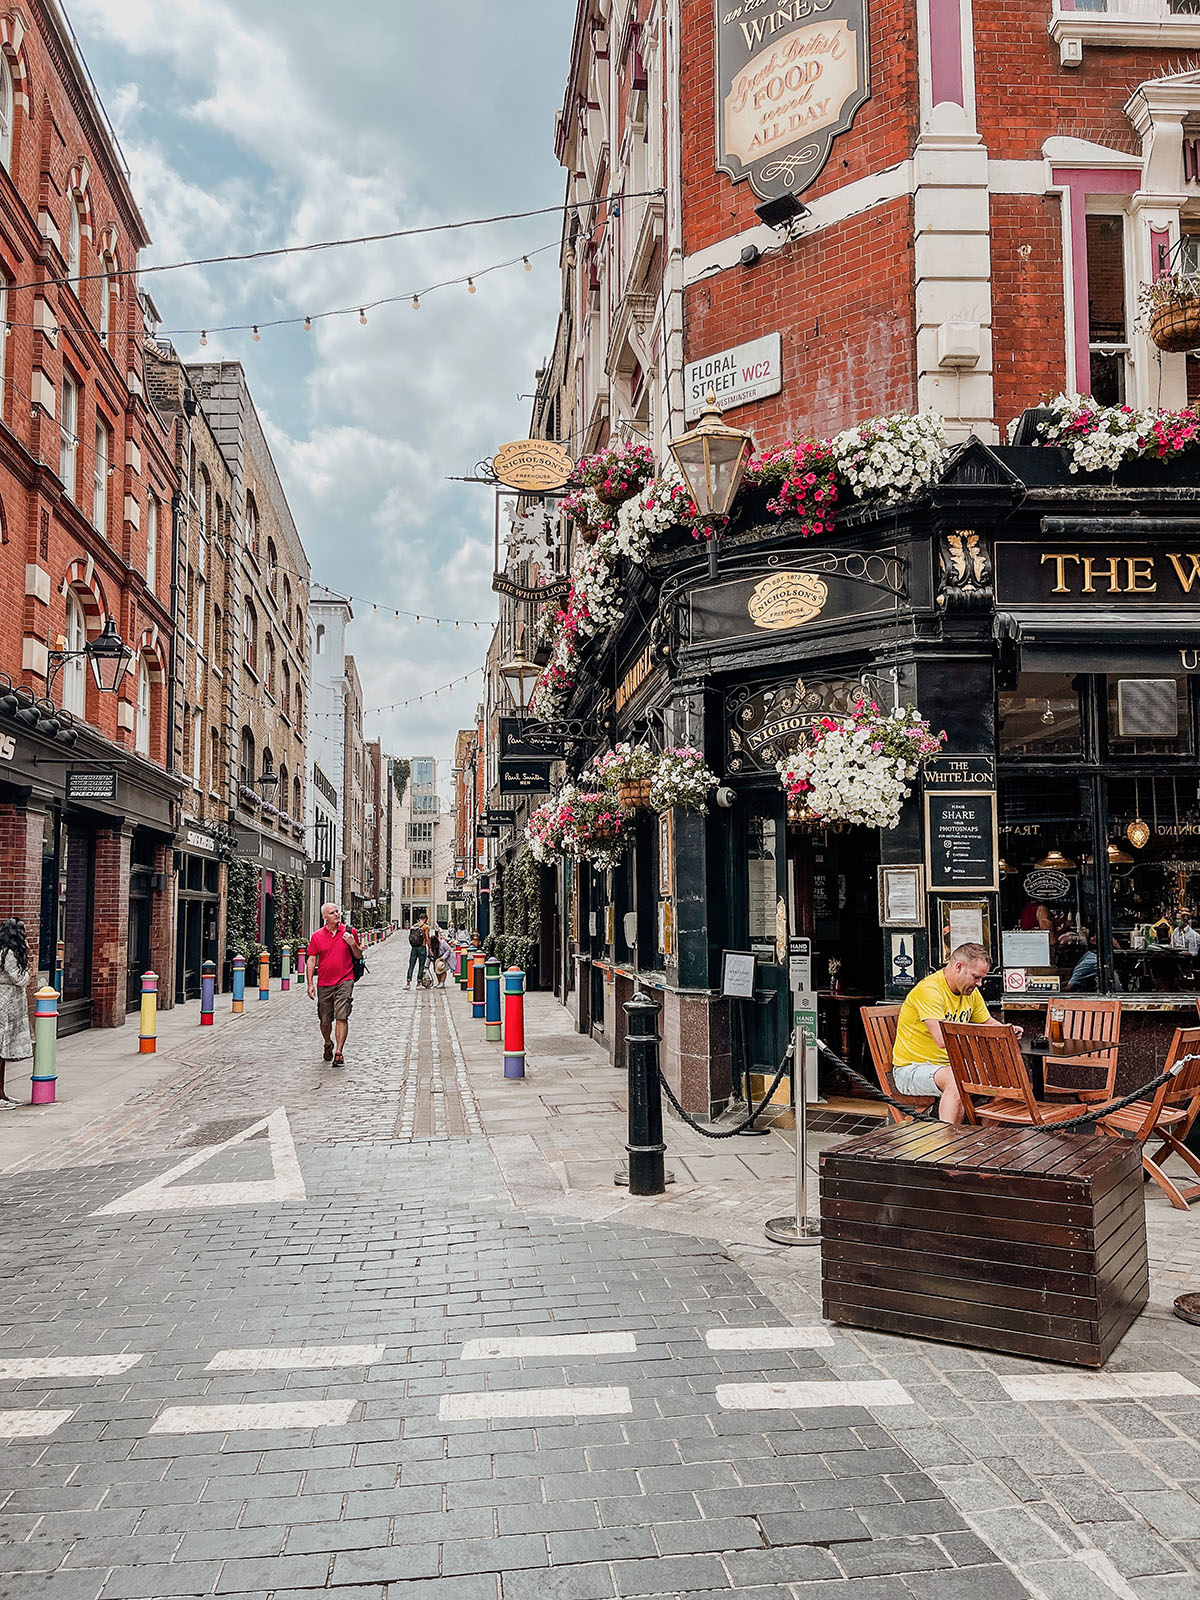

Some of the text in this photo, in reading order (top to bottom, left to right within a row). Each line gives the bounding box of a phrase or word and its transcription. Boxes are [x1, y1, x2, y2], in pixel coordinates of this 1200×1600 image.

[723, 6, 743, 24] an
[731, 30, 846, 113] Great British
[753, 60, 823, 110] FOOD
[760, 83, 815, 126] served
[748, 97, 831, 152] ALL DAY
[692, 354, 737, 382] FLORAL
[742, 361, 770, 382] WC2
[502, 457, 564, 472] NICHOLSON'S
[1041, 553, 1157, 592] THE
[496, 581, 568, 599] THE WHITE LION
[757, 590, 818, 611] NICHOLSON'S
[770, 607, 804, 617] FREEHOUSE
[949, 762, 969, 770] THE
[504, 772, 545, 781] Paul Smith
[923, 771, 994, 782] WHITE LION
[942, 810, 976, 819] SHARE
